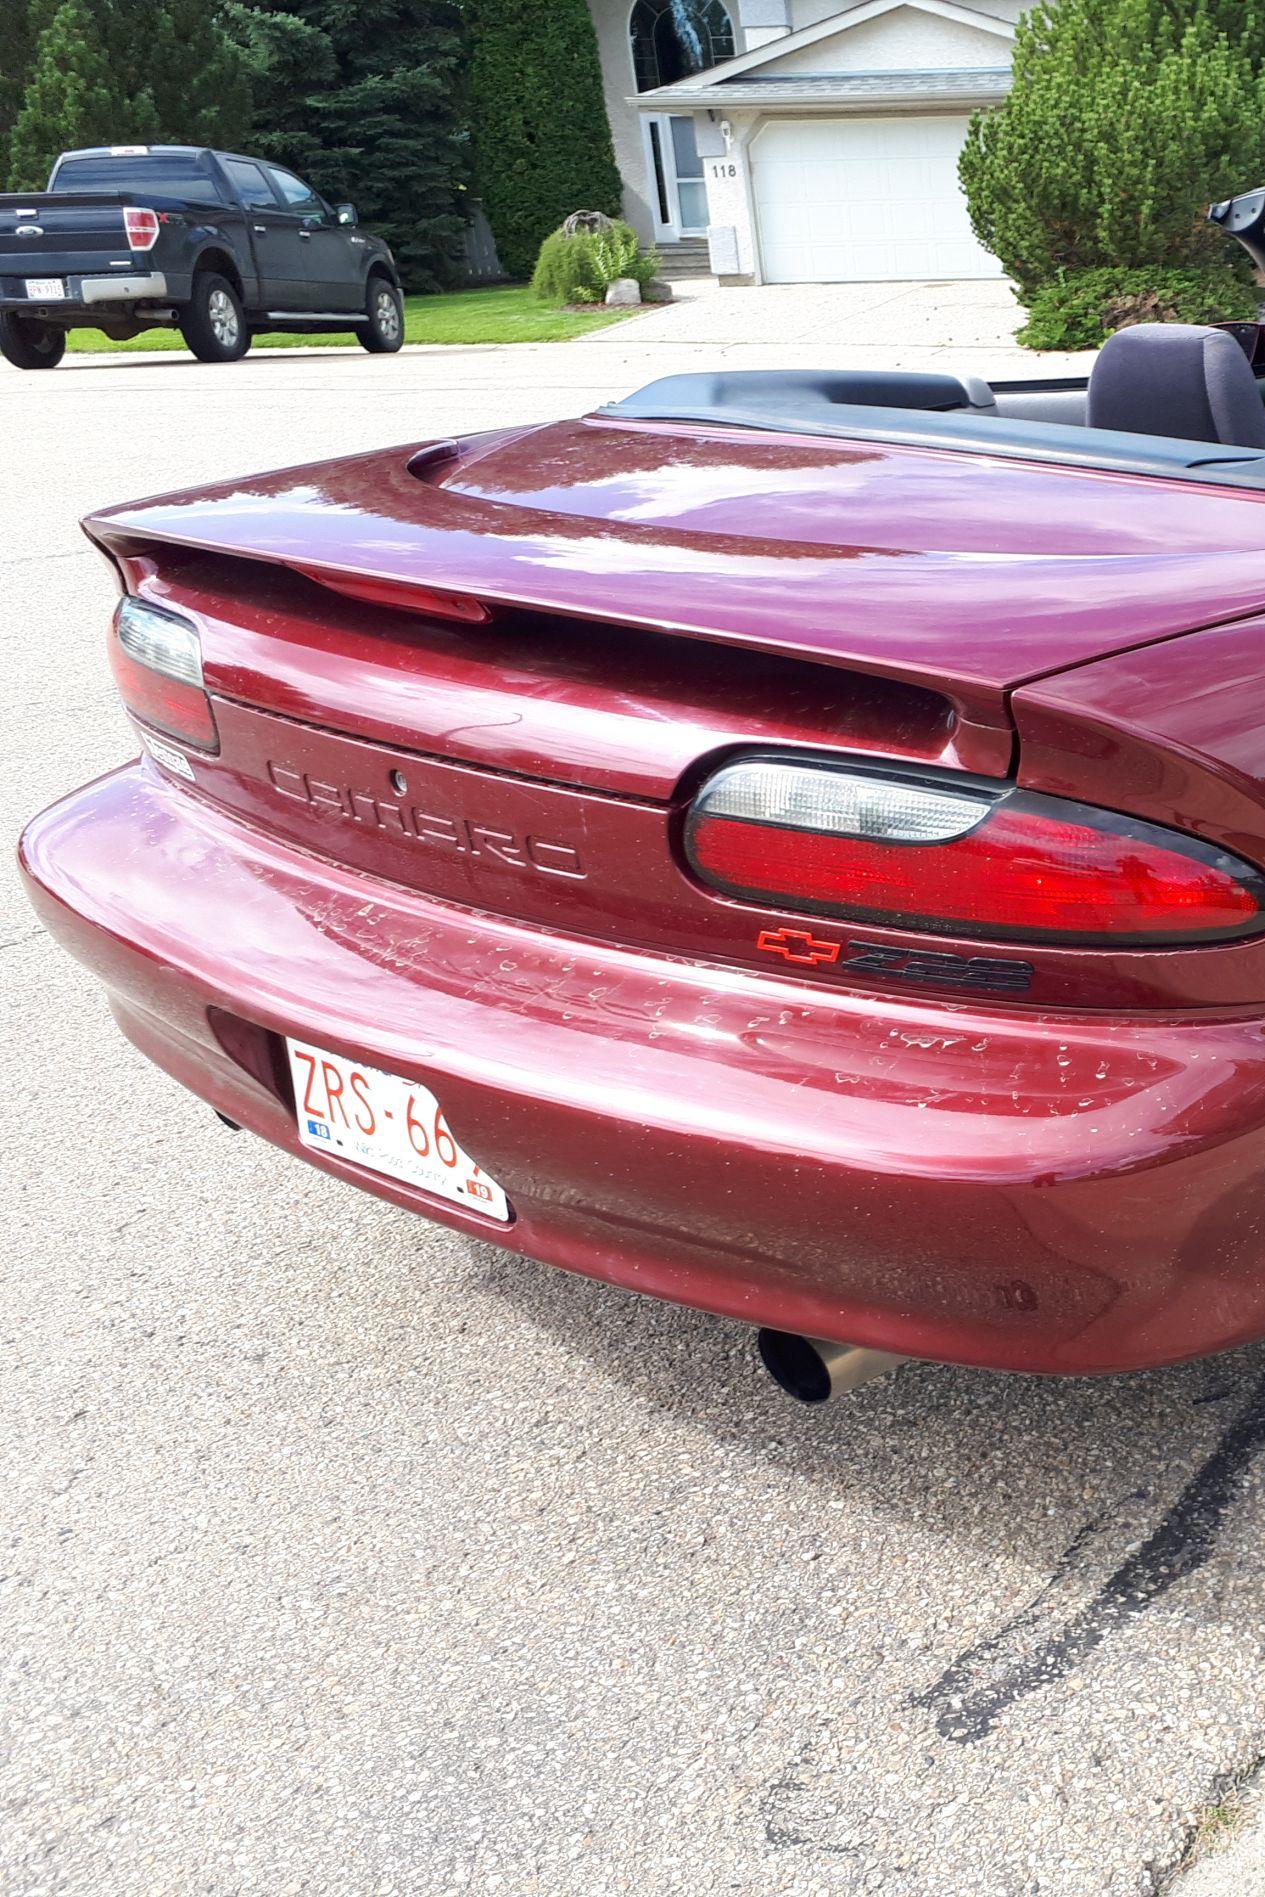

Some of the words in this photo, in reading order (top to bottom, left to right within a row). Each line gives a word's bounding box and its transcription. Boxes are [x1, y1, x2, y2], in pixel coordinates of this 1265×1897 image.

[713, 165, 736, 177] 118
[267, 760, 589, 879] CAMARO
[841, 940, 1035, 993] Z28
[295, 1051, 480, 1176] ZRS-66
